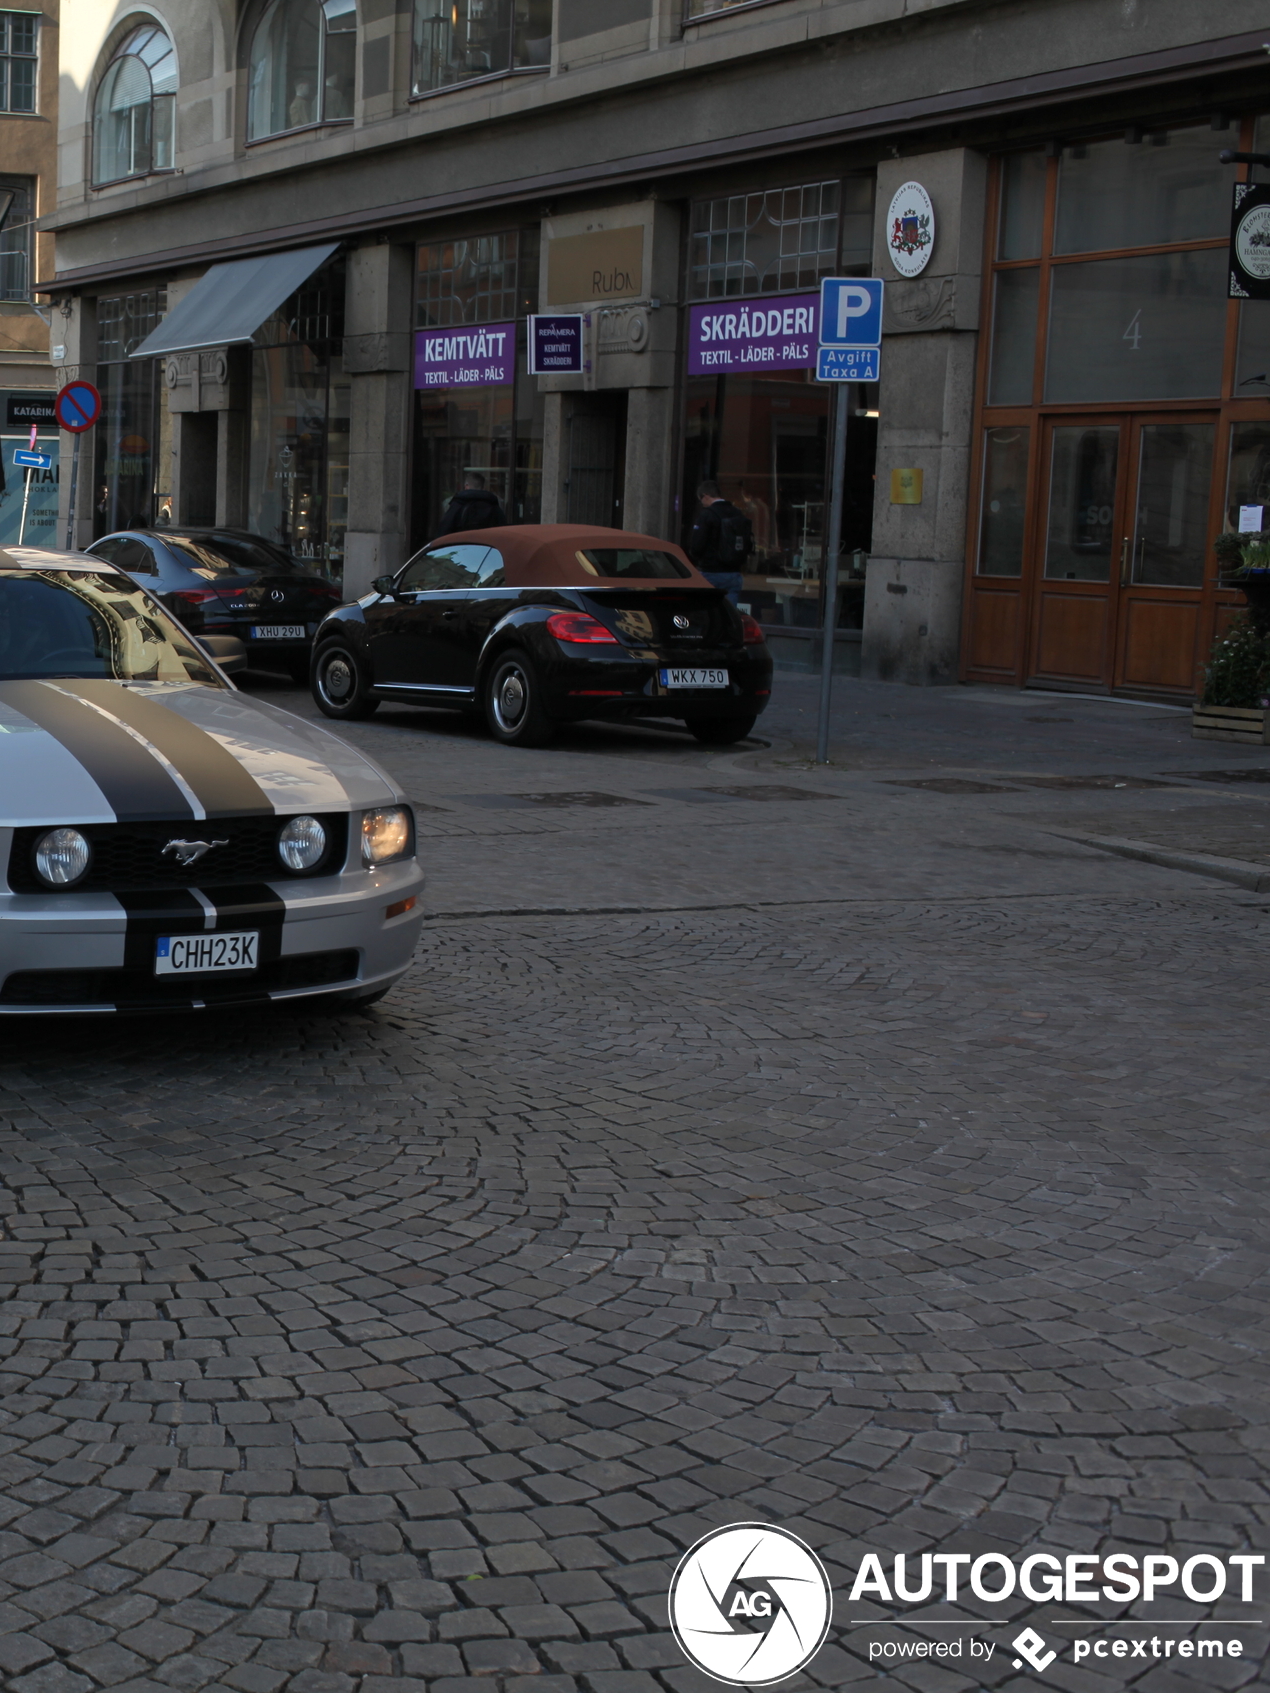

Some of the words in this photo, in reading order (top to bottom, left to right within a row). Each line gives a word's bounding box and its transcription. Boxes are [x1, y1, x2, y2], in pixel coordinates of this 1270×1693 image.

[1244, 248, 1270, 256] HAMNGA
[836, 285, 872, 338] P
[700, 306, 814, 341] SKRÄDDERI
[1122, 308, 1142, 350] 4
[425, 328, 506, 362] KEMTVÄTT
[544, 343, 571, 353] KEMTVÄTT
[700, 350, 733, 365] TEXTIL
[740, 345, 775, 363] LÄDER
[782, 342, 809, 360] PÄLS
[543, 356, 572, 366] SKRÄDDERI
[827, 350, 872, 365] Avgift
[425, 371, 449, 384] TEXTIL
[454, 367, 479, 383] LÄDER
[485, 365, 504, 381] PÄLS
[823, 365, 858, 378] Taxa
[863, 365, 873, 378] A
[259, 627, 279, 637] XHU
[282, 627, 301, 637] 29U
[671, 670, 697, 683] WKX
[700, 670, 724, 683] 750
[171, 936, 255, 969] CHH23K
